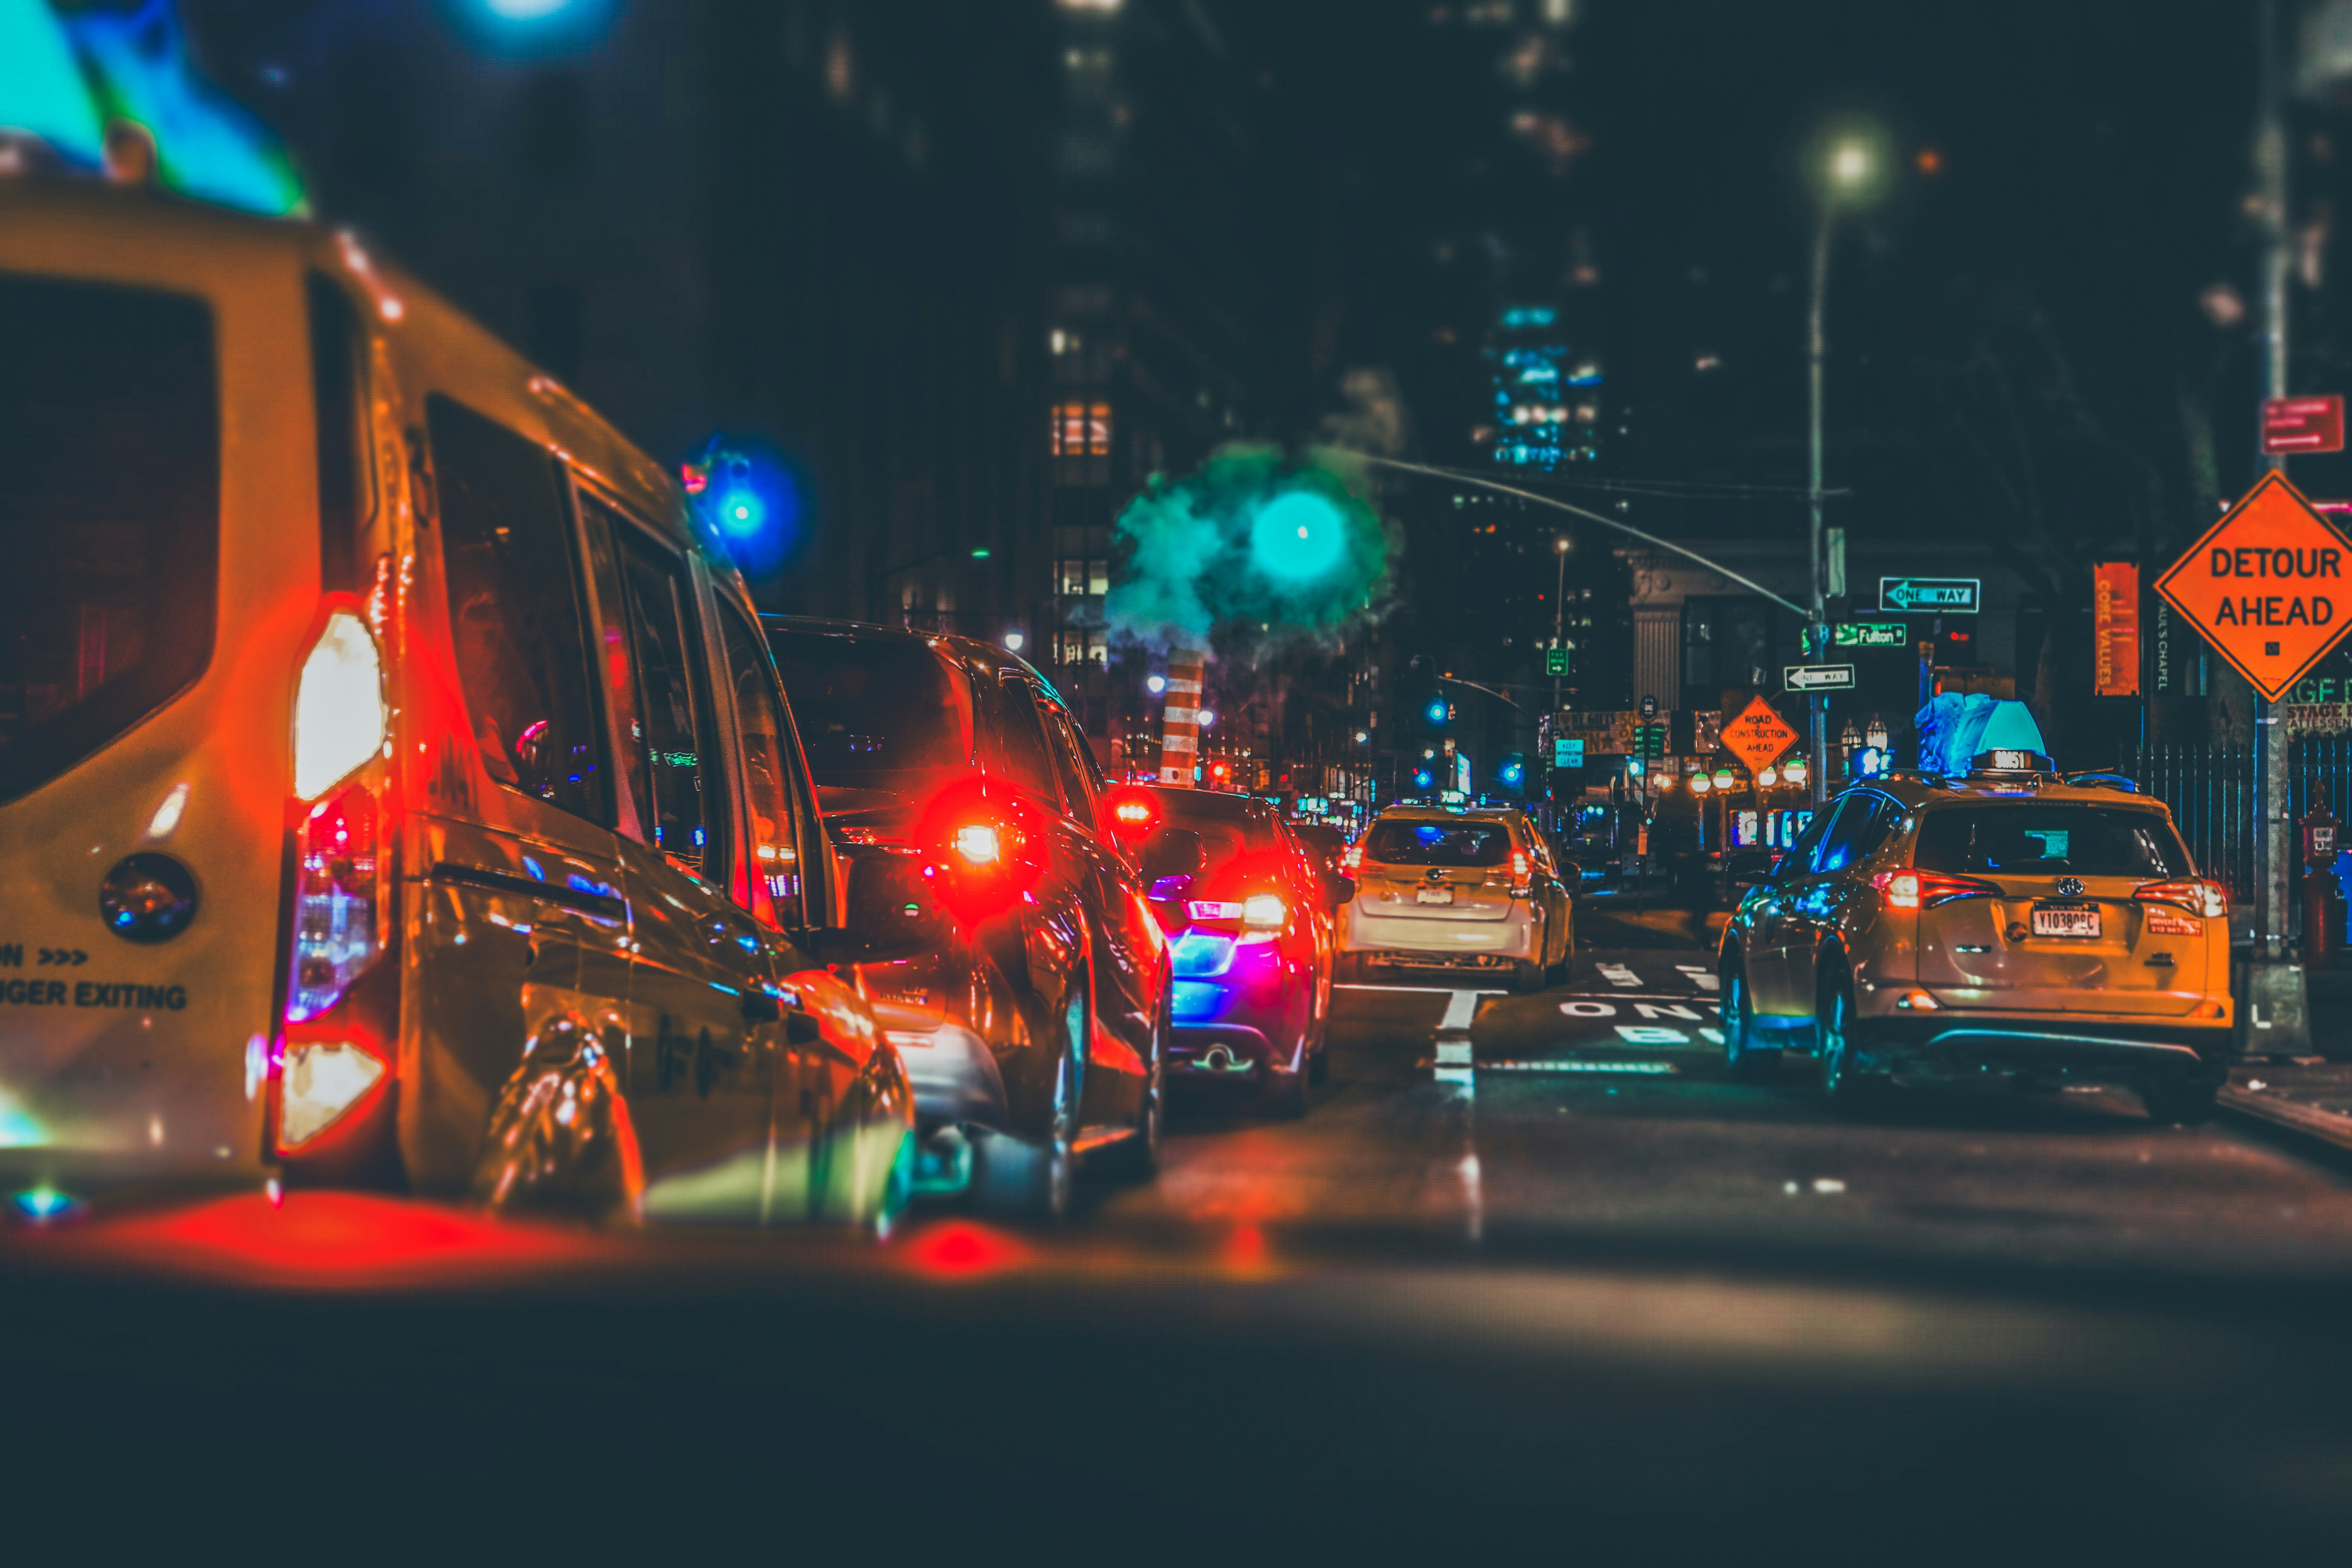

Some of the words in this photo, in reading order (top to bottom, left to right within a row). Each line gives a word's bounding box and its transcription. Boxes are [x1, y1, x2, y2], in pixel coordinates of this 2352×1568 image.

[2211, 547, 2341, 578] DETOUR
[1896, 589, 1922, 600] ONE
[1937, 589, 1965, 601] WAY
[2098, 579, 2111, 623] CORE
[2214, 596, 2333, 626] AHEAD
[1859, 629, 1893, 644] Fulton
[2099, 629, 2111, 685] VALUES
[2158, 641, 2168, 691] CHAPEL
[1745, 715, 1772, 724] ROAD
[2286, 704, 2342, 718] STAGE
[1730, 729, 1788, 738] CONSTRUCTION
[1747, 743, 1774, 752] AHEAD
[74, 982, 187, 1011] EXITING
[1559, 1001, 1721, 1020] ON
